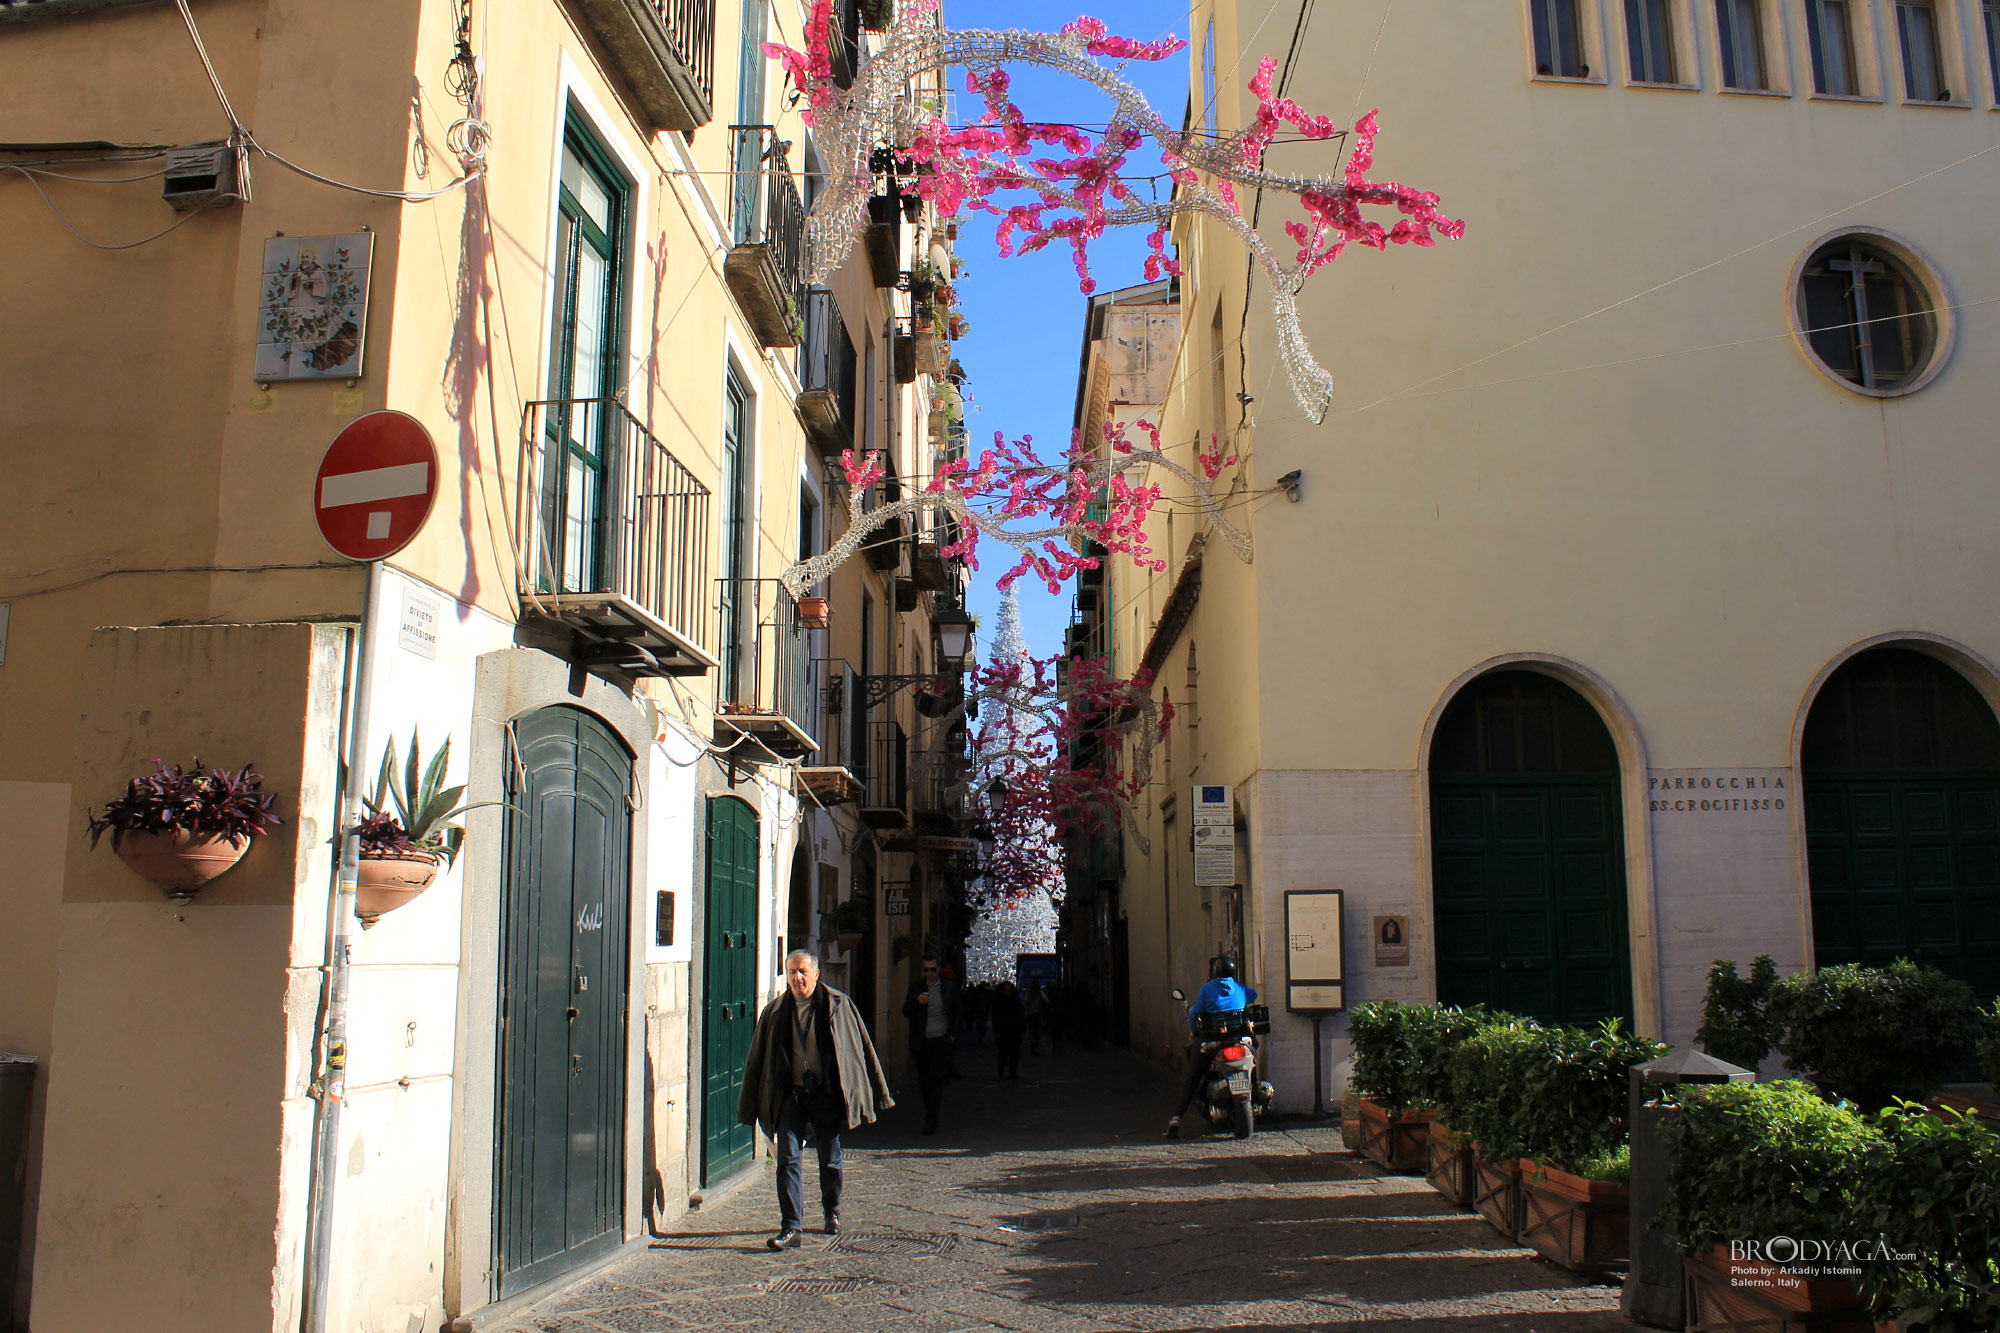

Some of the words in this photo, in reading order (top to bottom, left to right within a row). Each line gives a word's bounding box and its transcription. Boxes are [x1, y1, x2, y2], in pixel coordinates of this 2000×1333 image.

[409, 606, 433, 623] DIVIETO
[402, 623, 436, 644] AFFISSIONE
[1649, 777, 1784, 790] PARROCCHIA
[921, 839, 975, 849] CALZEDONIA
